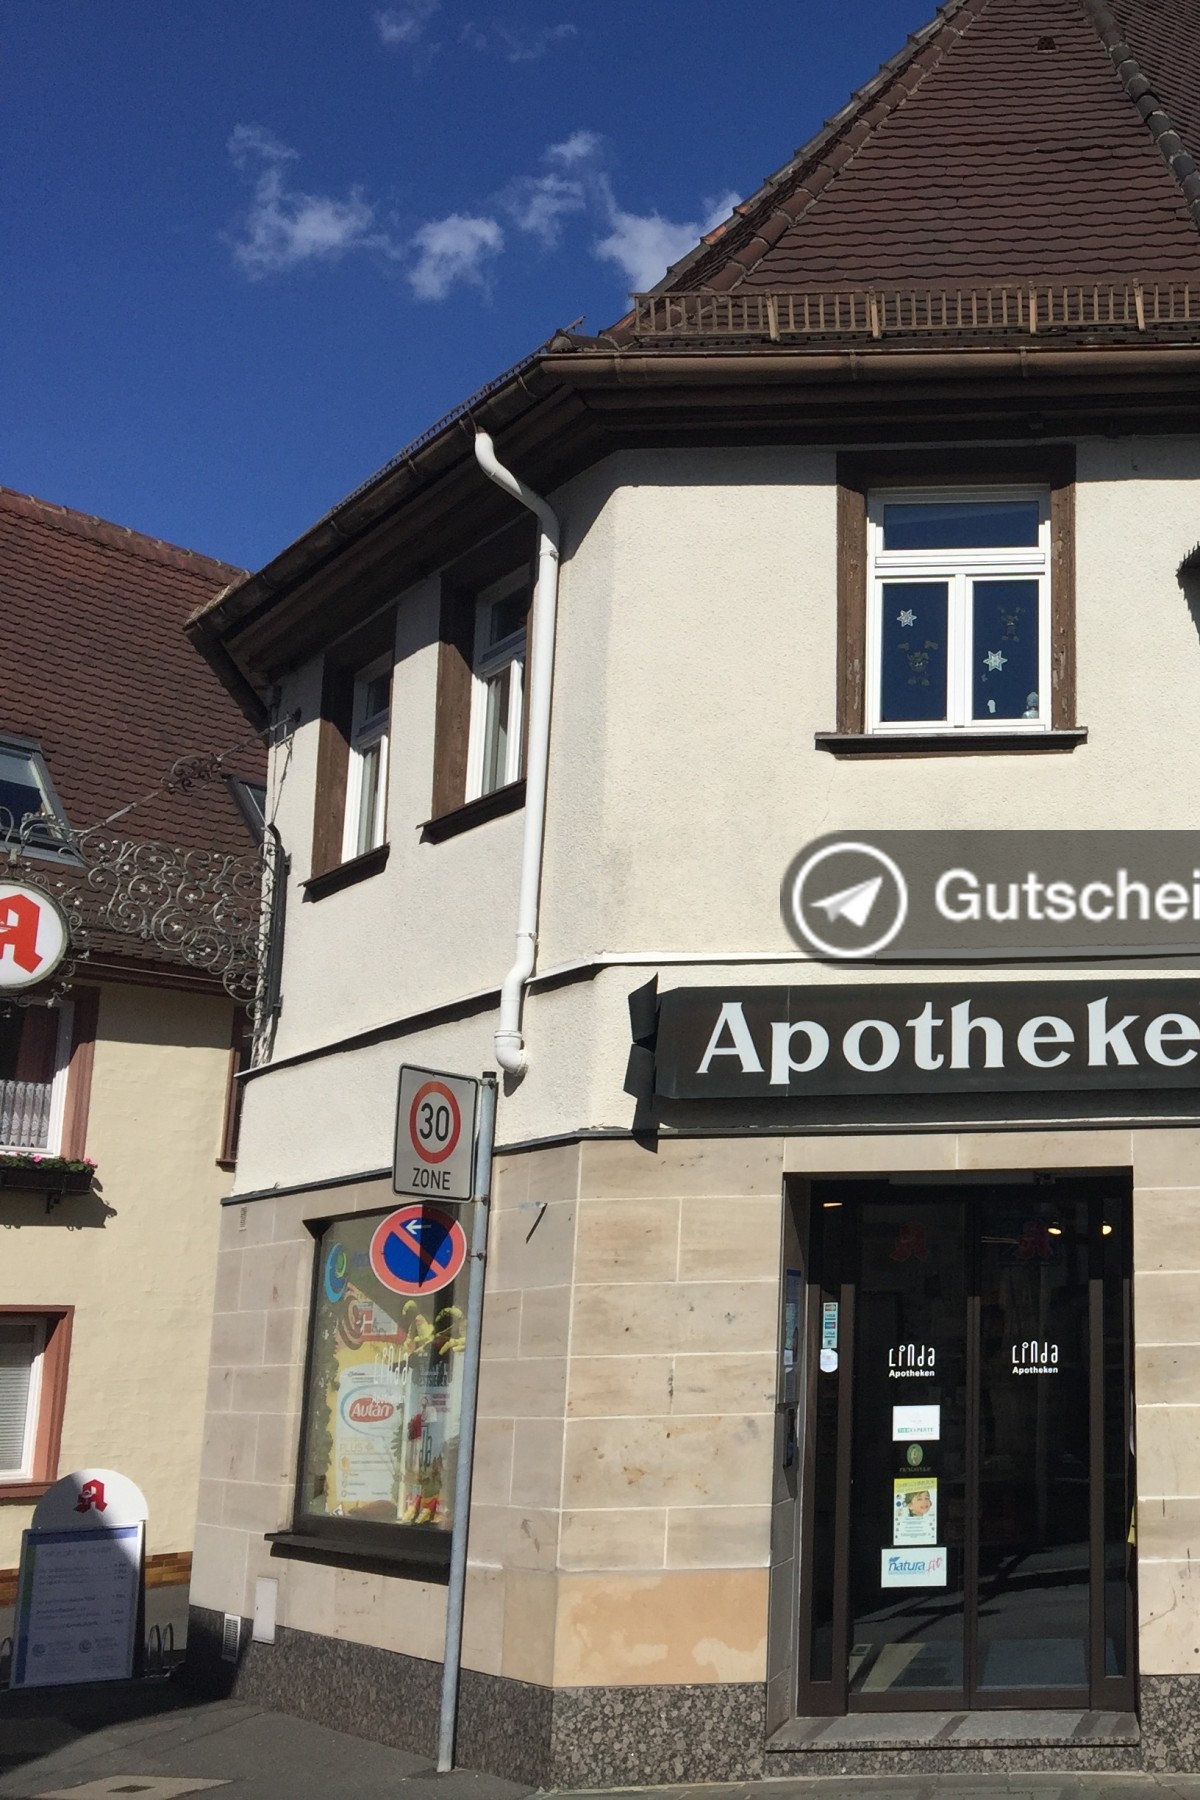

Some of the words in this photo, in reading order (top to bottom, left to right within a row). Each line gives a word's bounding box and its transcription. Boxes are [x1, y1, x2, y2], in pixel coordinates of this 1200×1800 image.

[696, 995, 1200, 1086] Apotheke
[419, 1102, 450, 1142] 30
[411, 1167, 451, 1191] ZONE
[888, 1369, 936, 1379] Apotheken
[1012, 1366, 1059, 1376] Apotheken
[351, 1401, 391, 1418] Autan
[888, 1559, 926, 1572] natura
